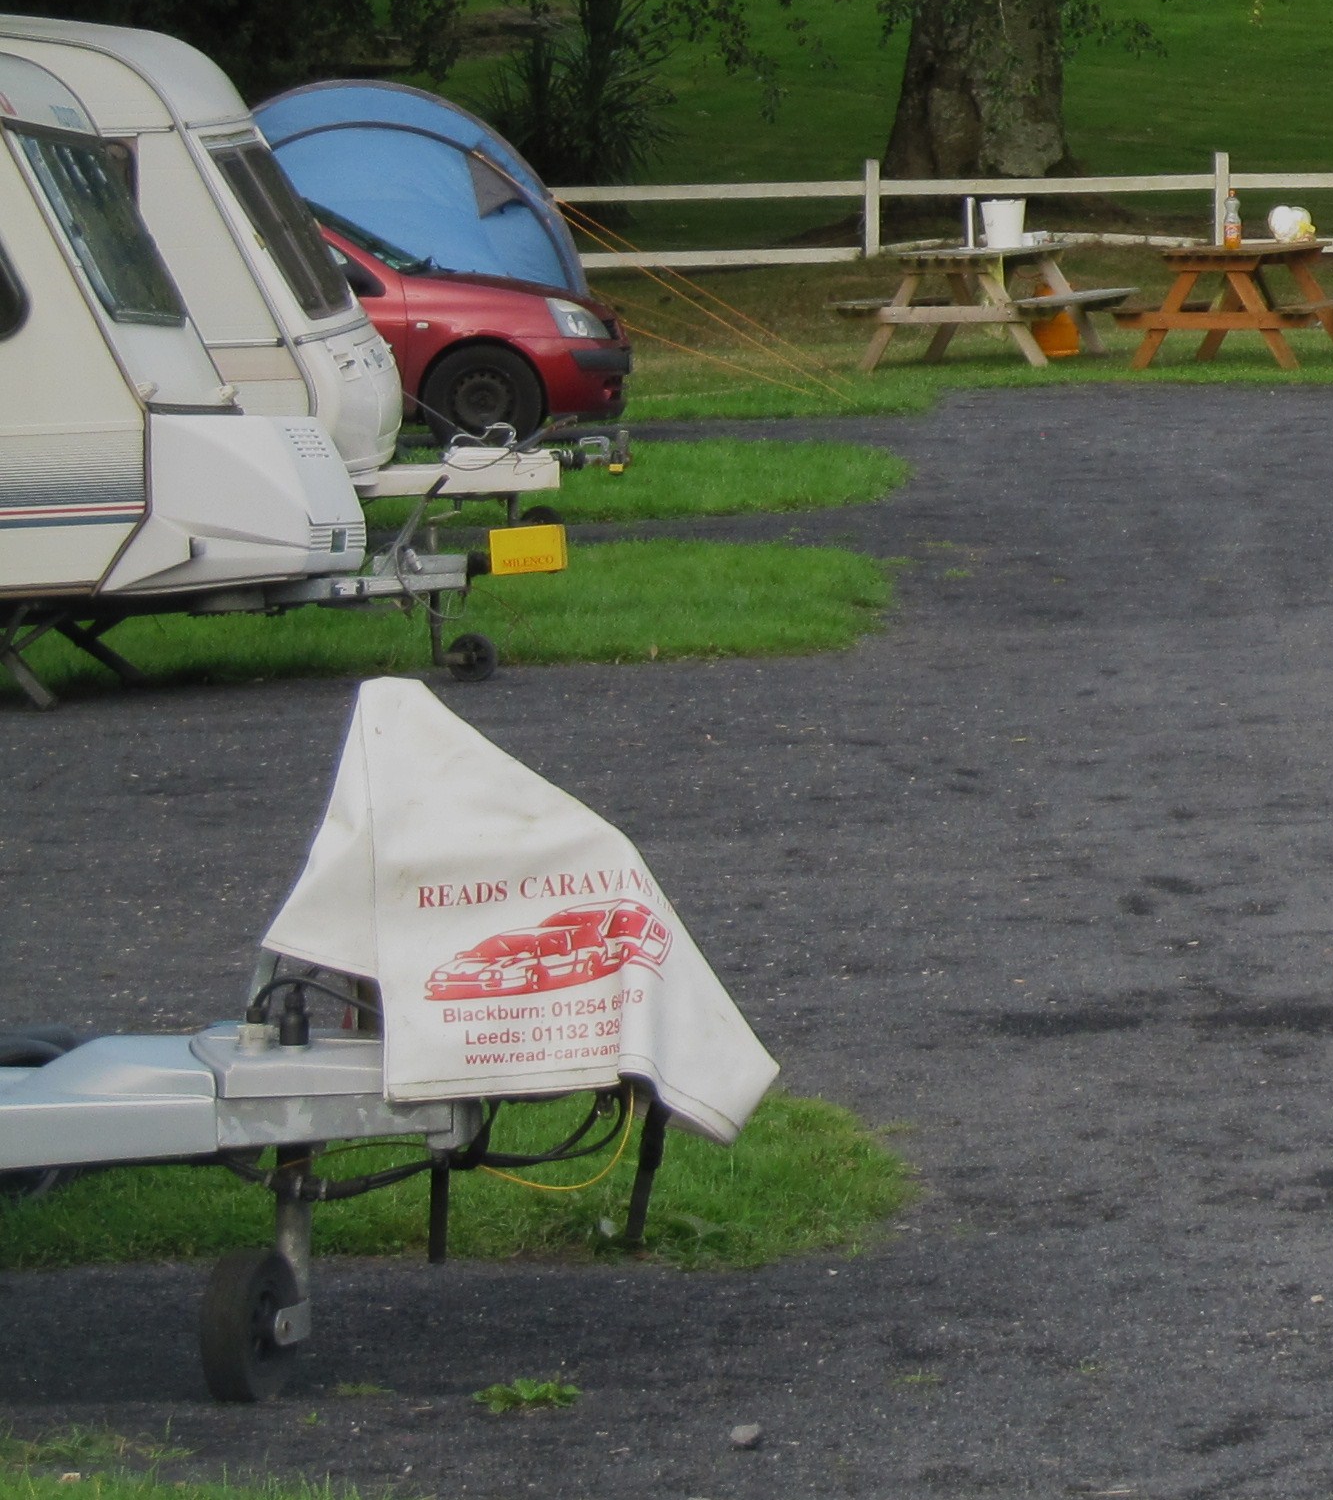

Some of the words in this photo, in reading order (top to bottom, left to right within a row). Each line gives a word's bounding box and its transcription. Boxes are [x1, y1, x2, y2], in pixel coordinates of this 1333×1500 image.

[502, 555, 554, 568] MILENCO
[418, 879, 509, 909] READS
[518, 868, 654, 900] CARAVANS
[442, 1004, 546, 1023] Blackburn:
[551, 998, 608, 1018] 01254
[465, 1028, 526, 1046] Leeds:
[531, 1022, 589, 1043] 01132
